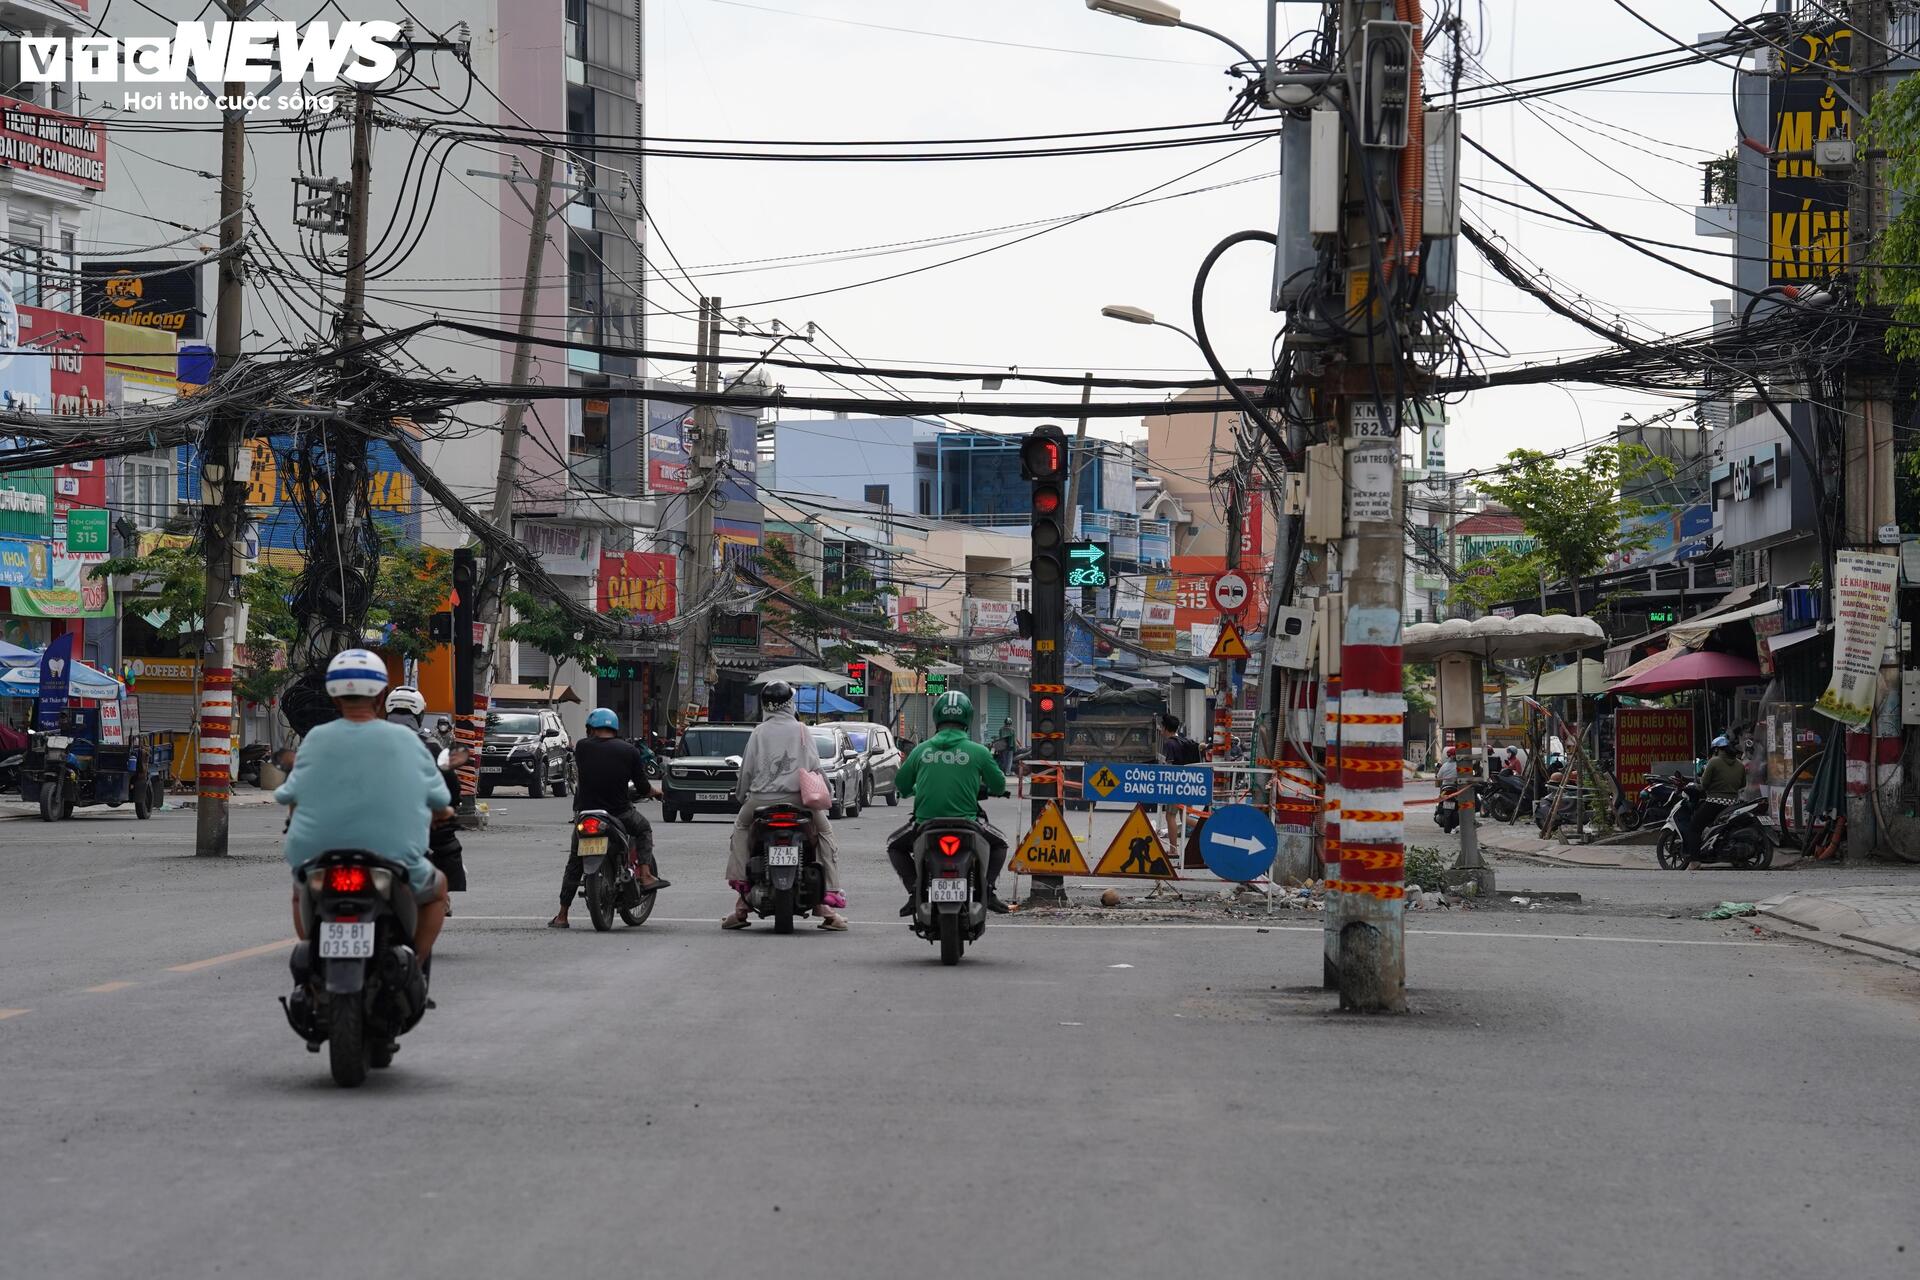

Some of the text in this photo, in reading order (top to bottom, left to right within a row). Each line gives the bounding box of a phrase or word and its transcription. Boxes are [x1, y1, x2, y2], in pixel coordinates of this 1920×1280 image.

[38, 116, 61, 140] ANH
[43, 149, 105, 182] CAMBRIDGE
[76, 532, 98, 543] 315
[2, 551, 26, 568] KHOA
[1176, 593, 1208, 609] 315
[144, 664, 179, 679] COFFEE
[180, 666, 188, 679] &
[942, 706, 963, 715] Grab
[1621, 713, 1640, 728] BÚN
[1667, 714, 1687, 728] TÔM
[921, 747, 970, 766] Grab
[1124, 768, 1205, 784] CÔNG TRƯỜNG
[1124, 782, 1207, 796] ĐANG THI CÔNG
[1043, 825, 1058, 841] ĐI
[772, 846, 794, 856] 72-AC
[1026, 846, 1071, 866] CHẬM
[770, 855, 798, 865] 231.76
[937, 880, 961, 890] 60-AC
[934, 889, 965, 900] 620.18
